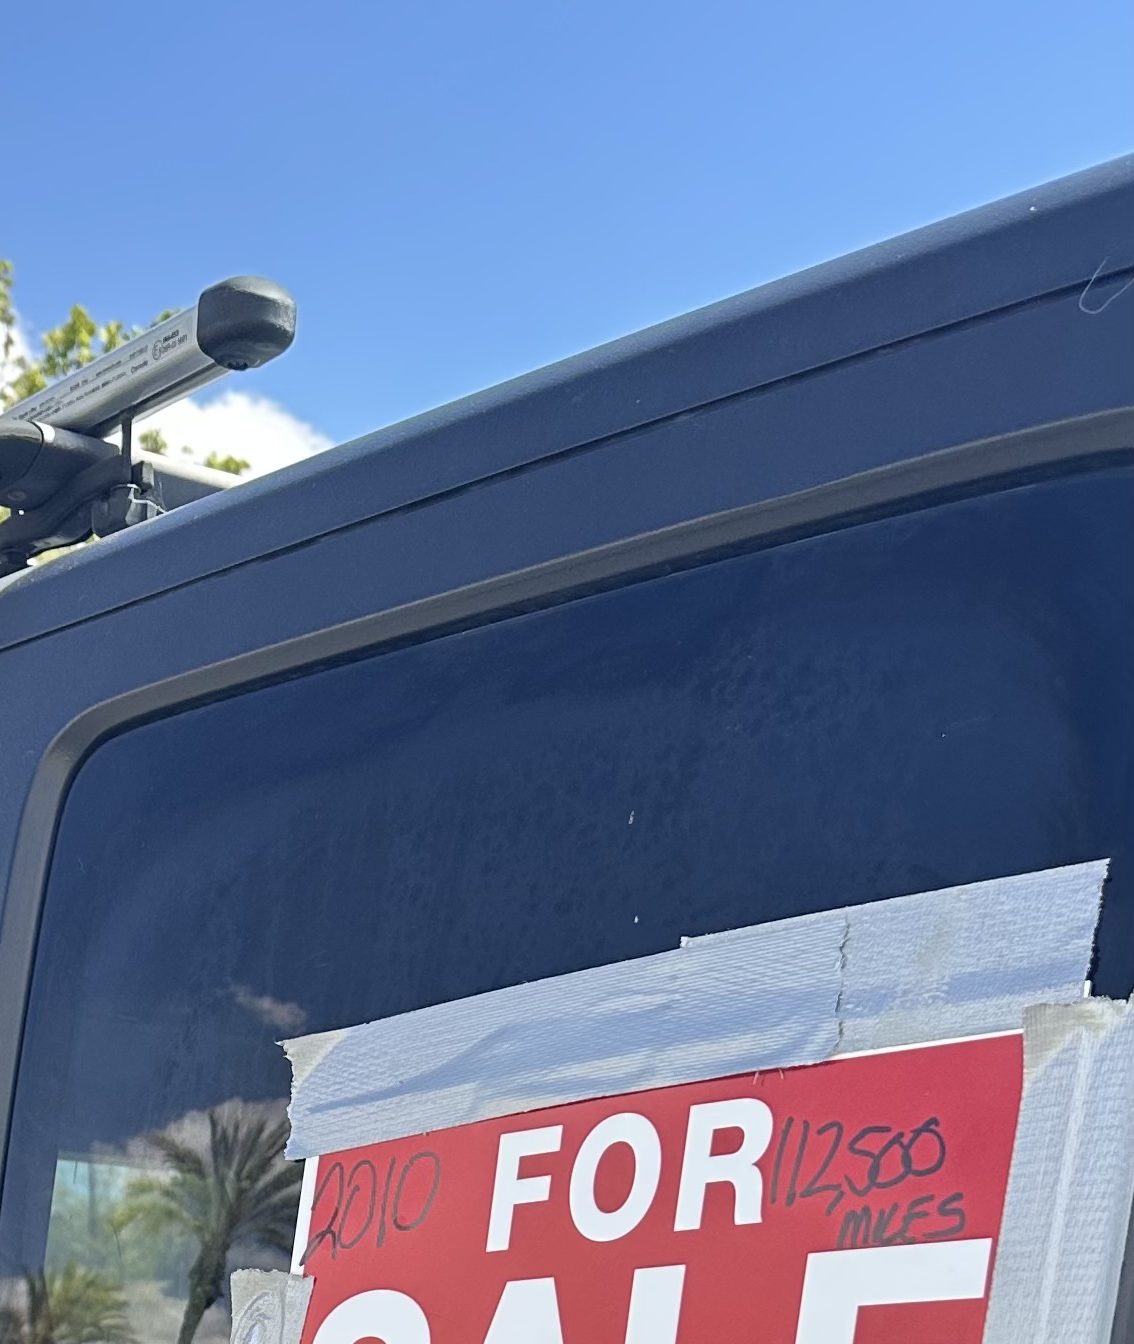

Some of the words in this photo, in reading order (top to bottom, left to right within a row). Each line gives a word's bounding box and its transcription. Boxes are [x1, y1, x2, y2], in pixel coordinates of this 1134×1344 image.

[299, 1151, 442, 1267] 2010
[485, 1096, 774, 1254] FOR
[770, 1116, 947, 1216] 112,500
[836, 1192, 967, 1250] MILES
